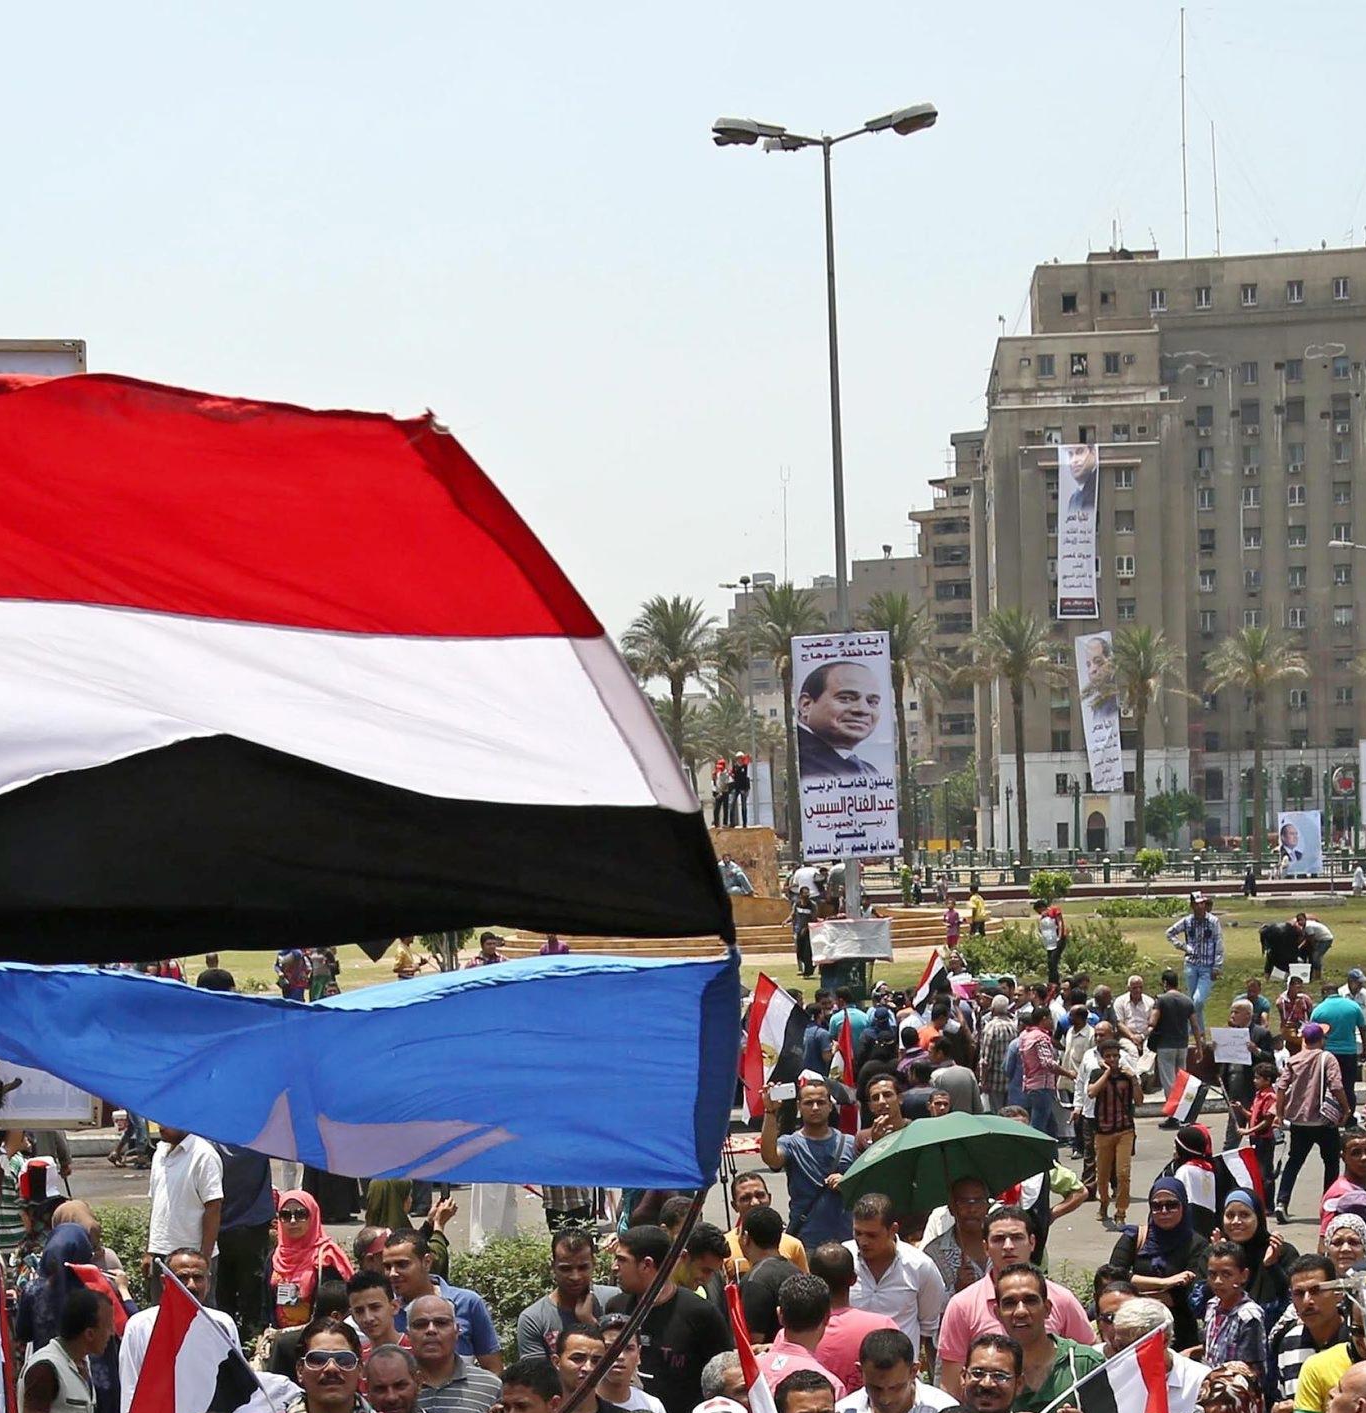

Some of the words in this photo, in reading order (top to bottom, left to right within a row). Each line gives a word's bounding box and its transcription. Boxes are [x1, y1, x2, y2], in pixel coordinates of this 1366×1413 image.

[801, 639, 833, 650] شعب
[801, 652, 838, 662] سوهاج
[840, 648, 884, 658] محافظة
[803, 780, 836, 794] الرئيس
[838, 777, 868, 788] فخامة
[868, 776, 894, 790] يهنئون
[804, 796, 847, 824] السيسي
[847, 794, 876, 817] الفتاح
[877, 798, 895, 815] عبد
[817, 820, 858, 831] الجمهورية
[858, 817, 887, 828] رئيس
